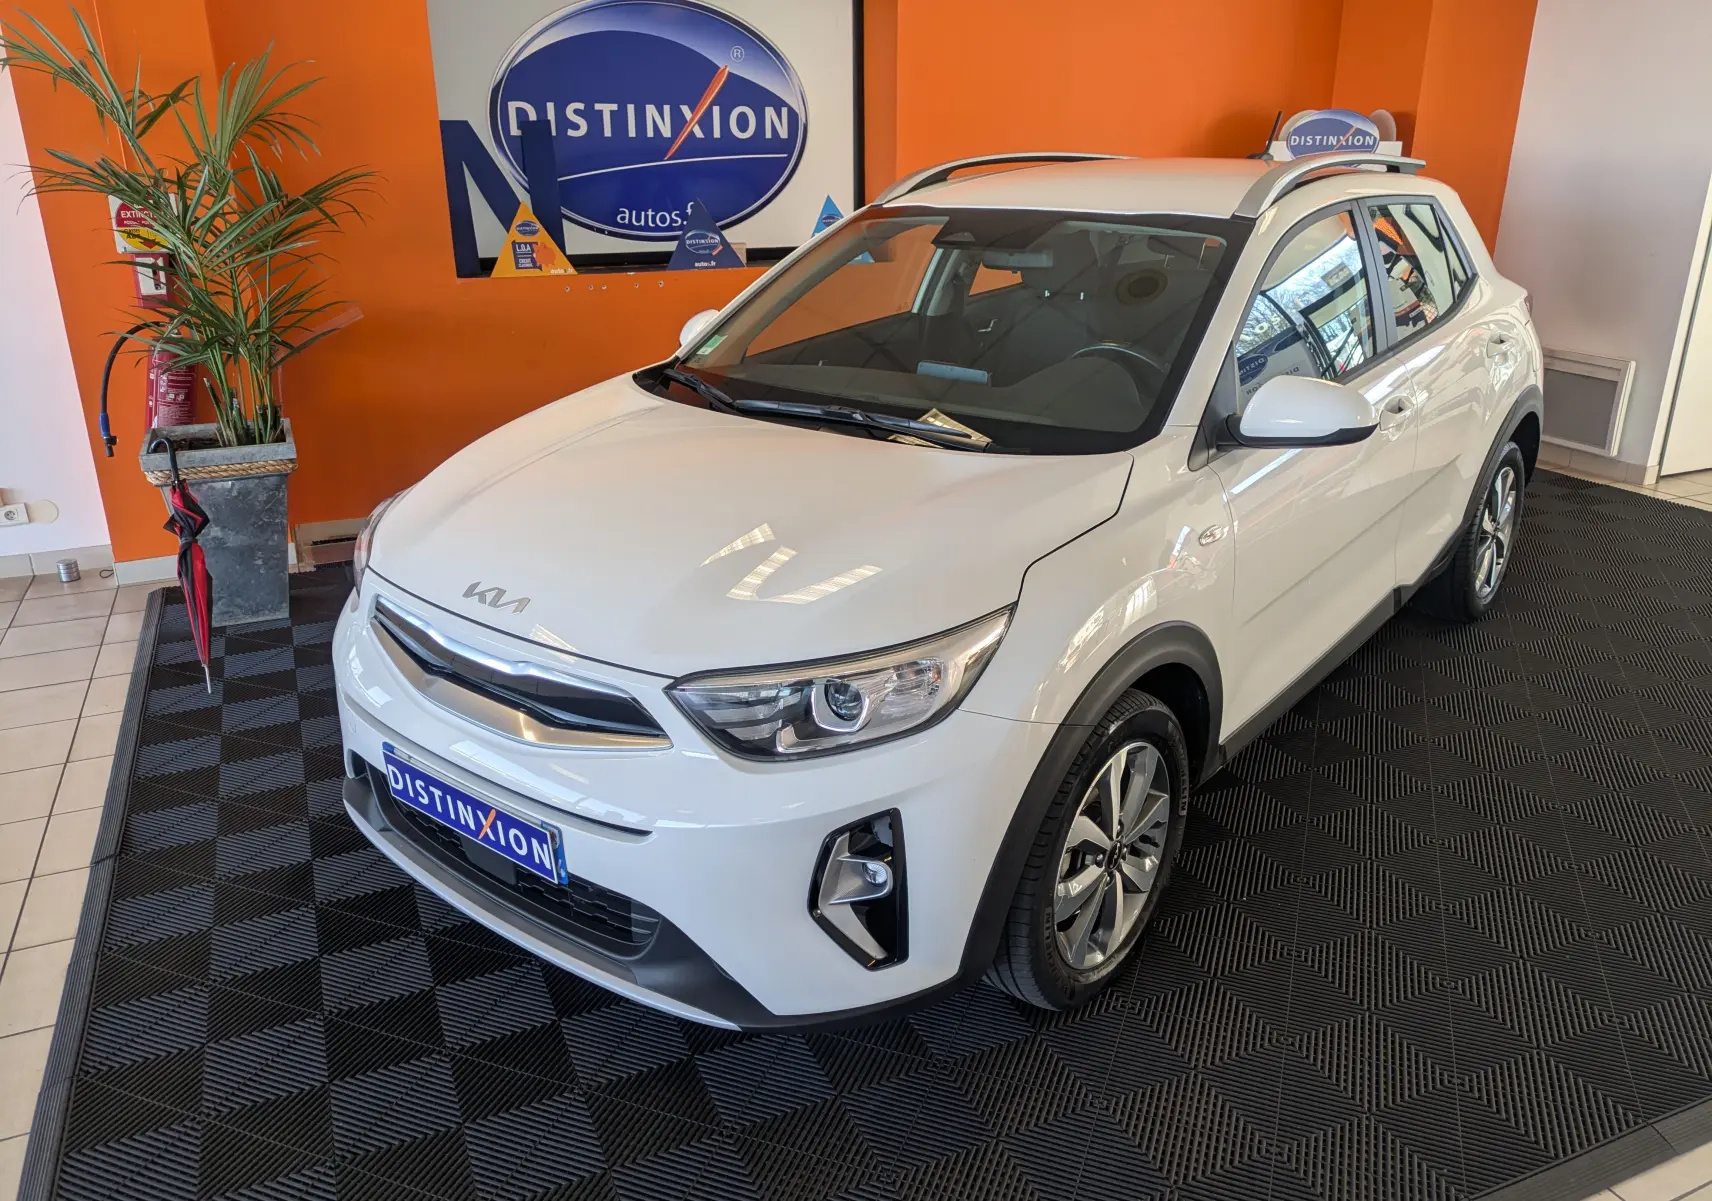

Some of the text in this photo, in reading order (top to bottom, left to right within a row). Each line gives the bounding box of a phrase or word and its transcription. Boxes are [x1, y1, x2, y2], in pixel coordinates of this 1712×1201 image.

[507, 100, 789, 139] DISTINXION
[1290, 135, 1374, 146] DISTINXION
[121, 210, 158, 219] EXTINCT
[616, 201, 695, 226] autos.f
[386, 763, 552, 870] DISTINXION
